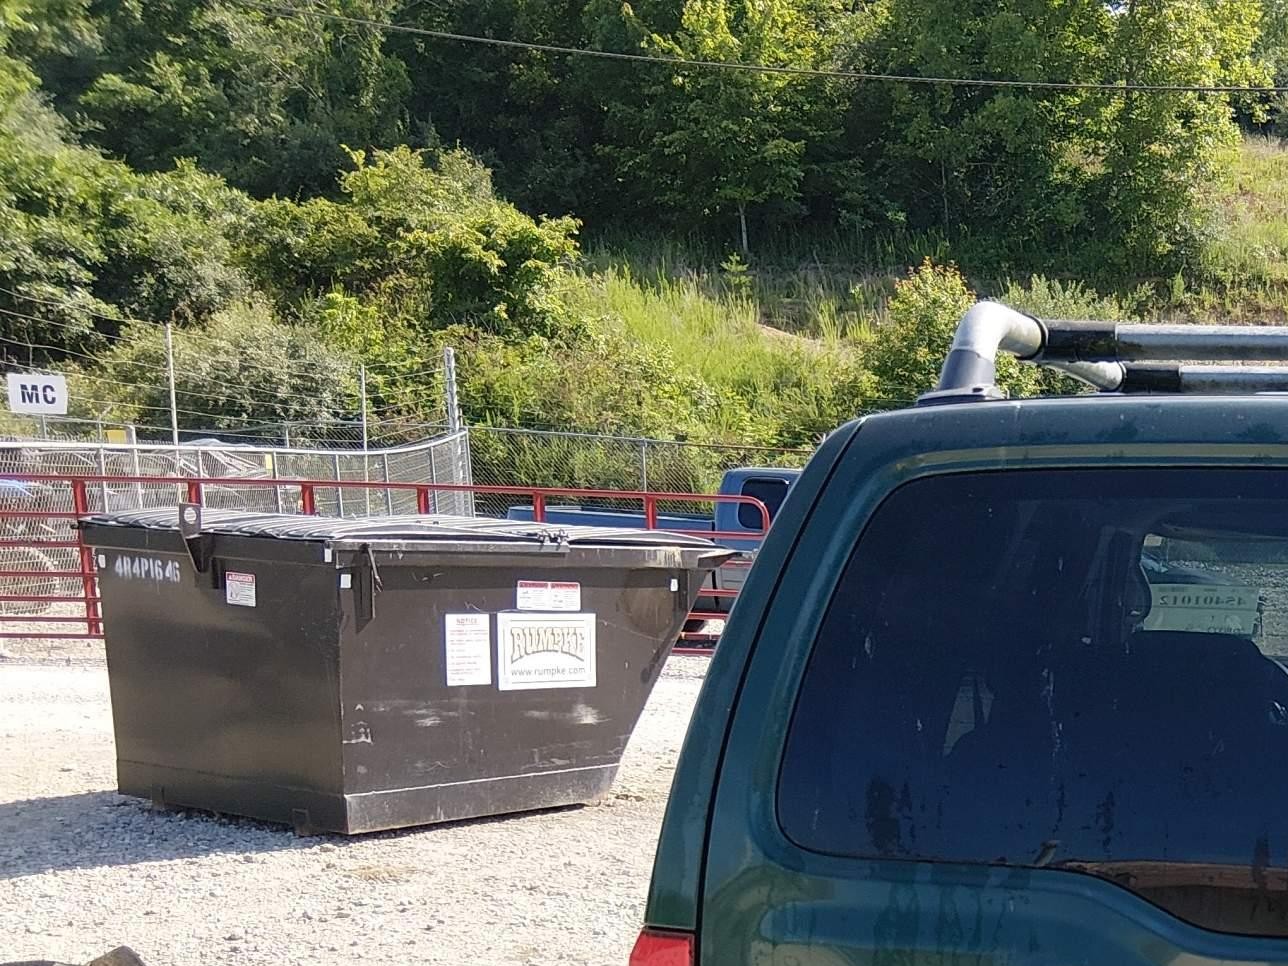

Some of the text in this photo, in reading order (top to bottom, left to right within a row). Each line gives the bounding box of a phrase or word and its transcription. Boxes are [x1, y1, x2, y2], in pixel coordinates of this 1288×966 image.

[20, 384, 56, 405] MC
[511, 626, 585, 664] RUMPKE
[511, 665, 586, 677] www.rumpke.com
